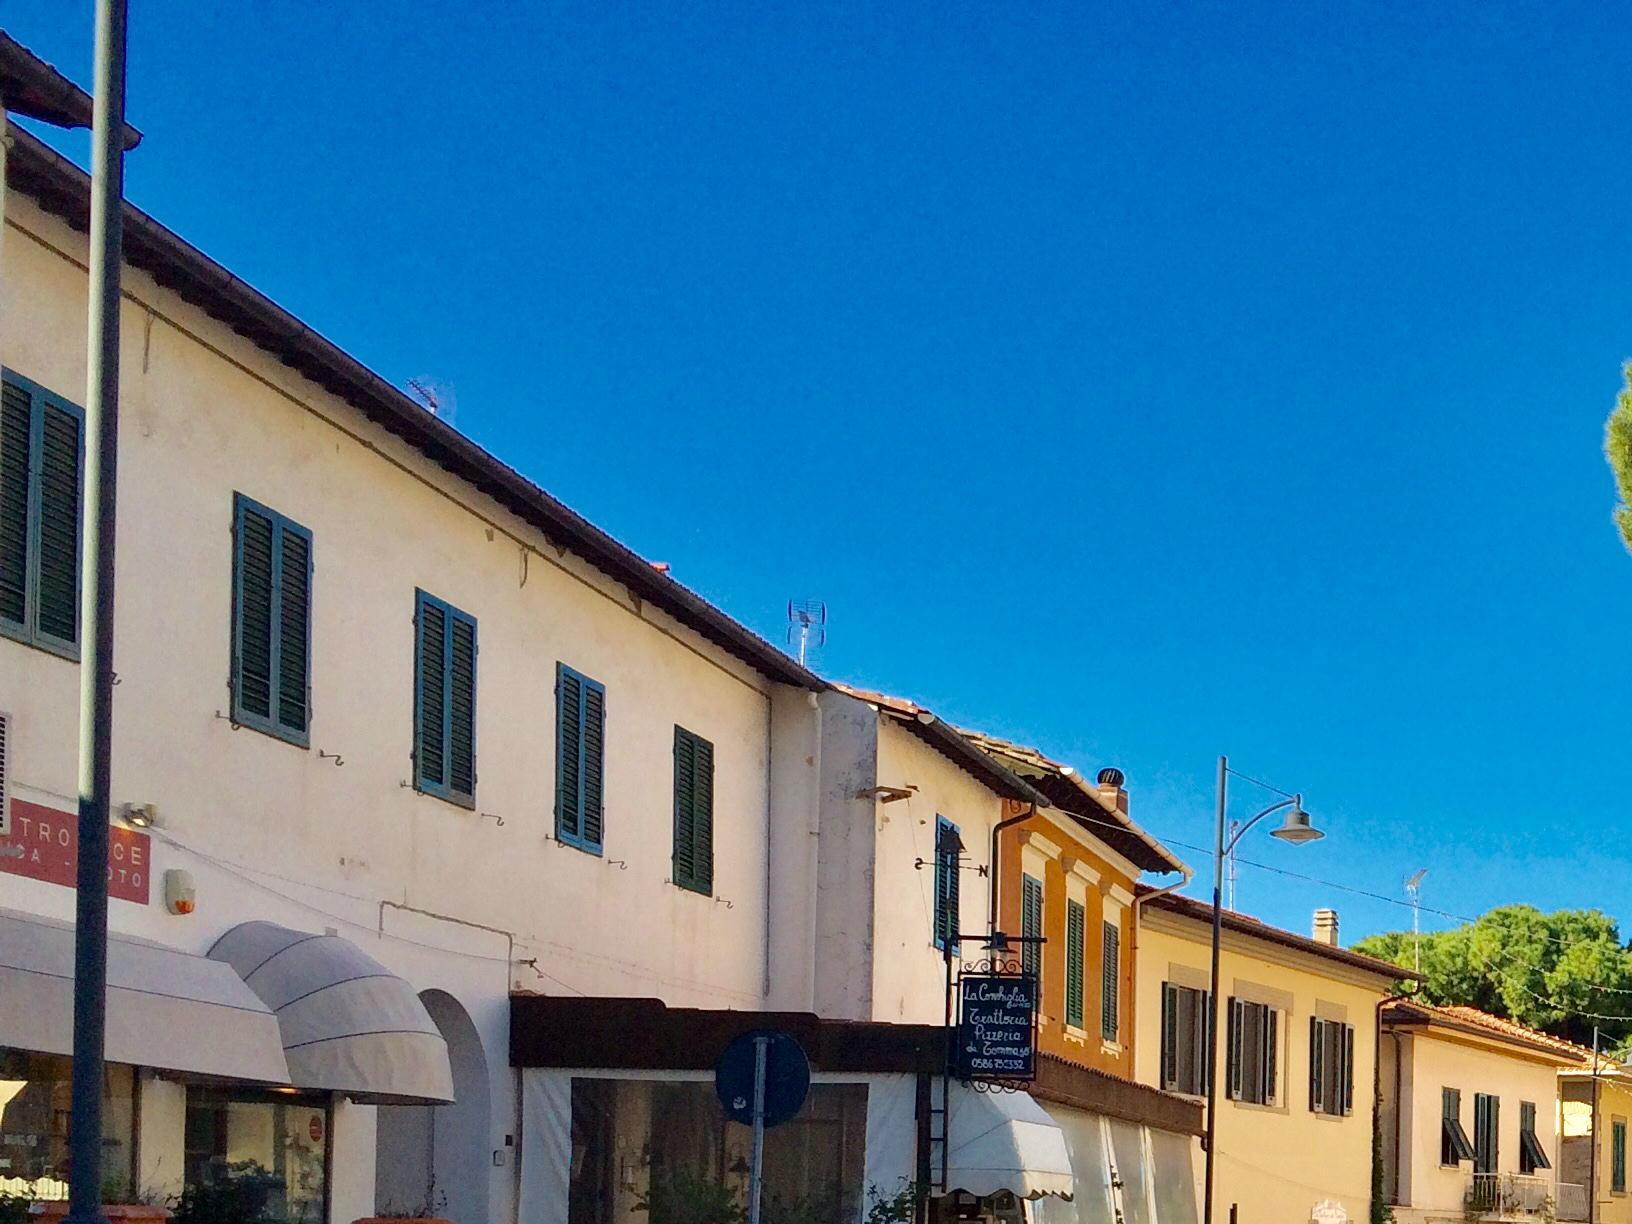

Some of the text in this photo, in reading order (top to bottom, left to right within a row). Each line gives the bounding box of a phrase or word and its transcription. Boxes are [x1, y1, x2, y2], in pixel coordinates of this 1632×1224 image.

[963, 985, 978, 1001] La
[969, 1008, 1029, 1025] Trattoria
[974, 1024, 1021, 1041] Pizzeria
